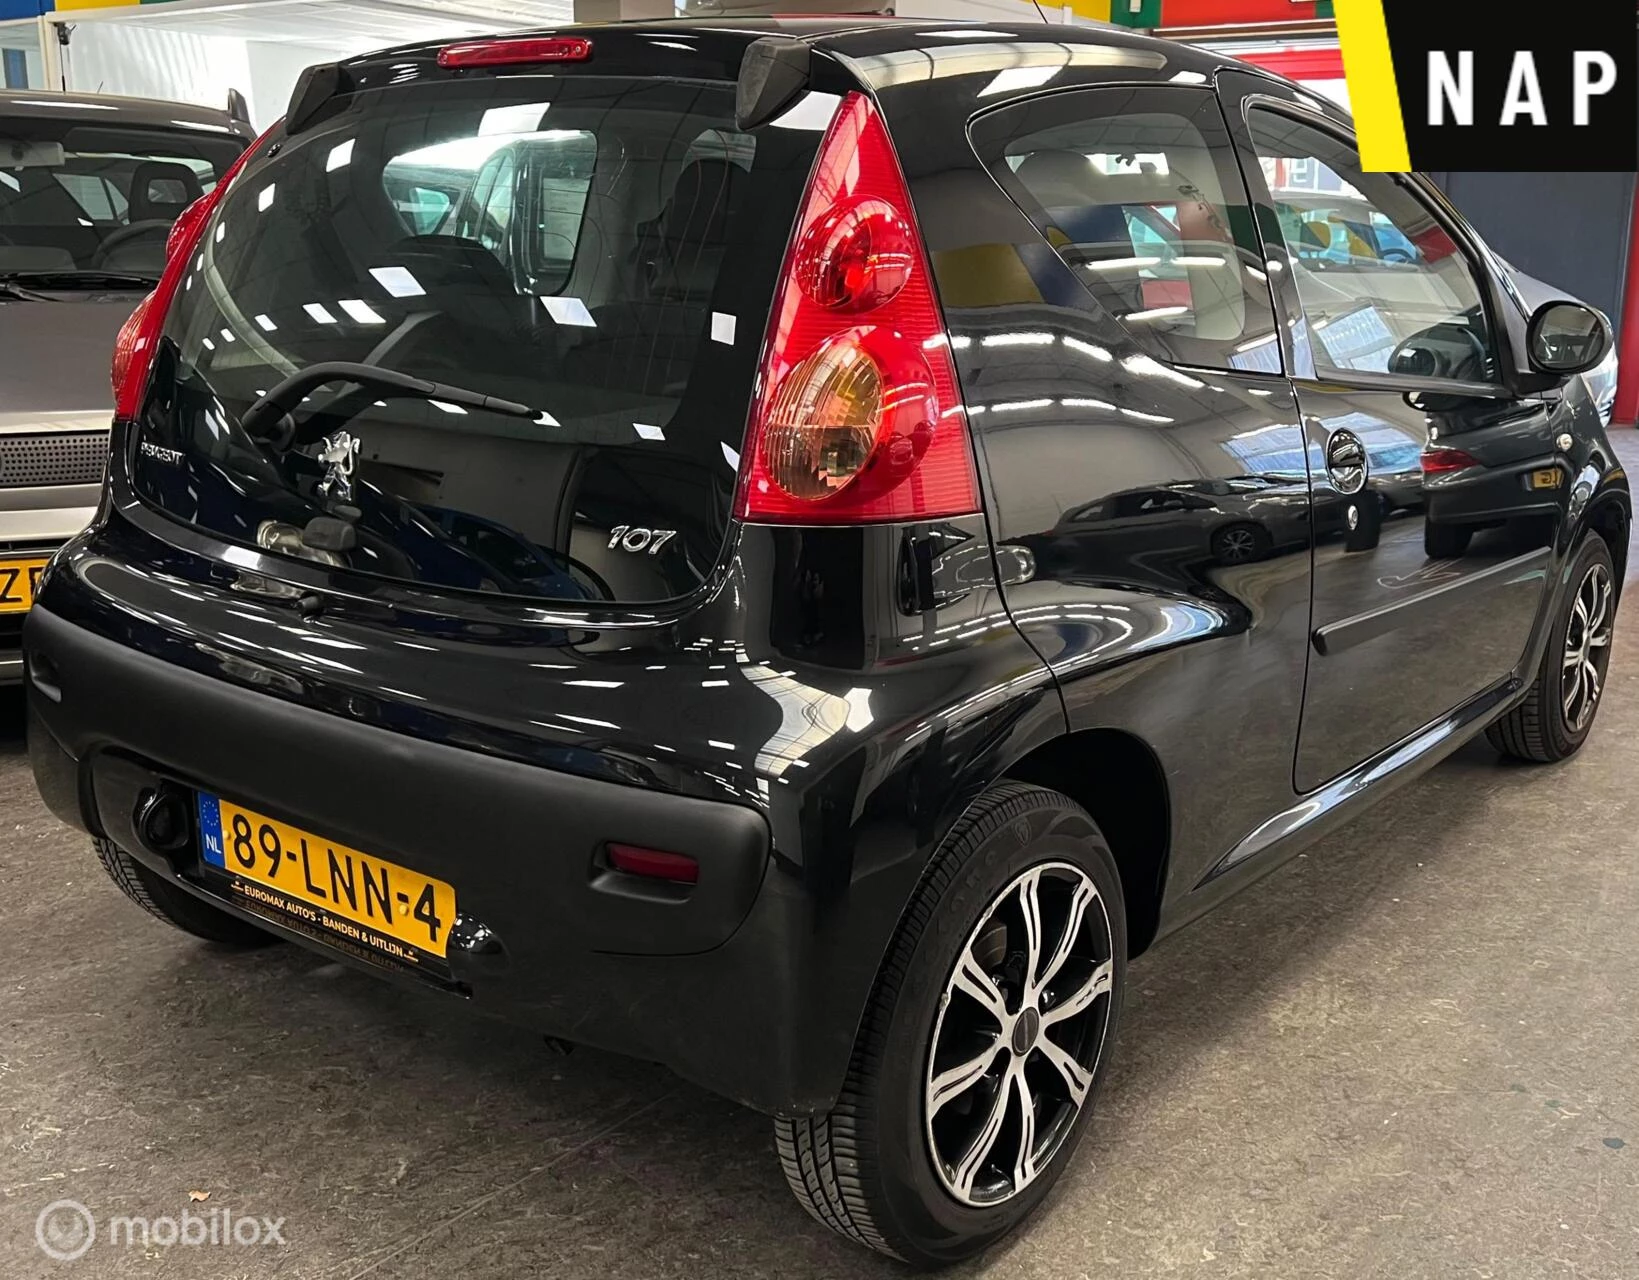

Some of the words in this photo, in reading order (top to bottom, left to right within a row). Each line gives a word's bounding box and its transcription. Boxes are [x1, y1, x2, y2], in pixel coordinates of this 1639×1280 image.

[607, 525, 677, 554] 107
[205, 833, 222, 854] NL
[232, 813, 442, 943] 89-LNN-4
[244, 884, 285, 910] EUROMAX
[286, 901, 317, 922] AUTO'S
[322, 915, 360, 940] BANDEN
[361, 931, 369, 943] &
[369, 934, 404, 958] UITLIJN
